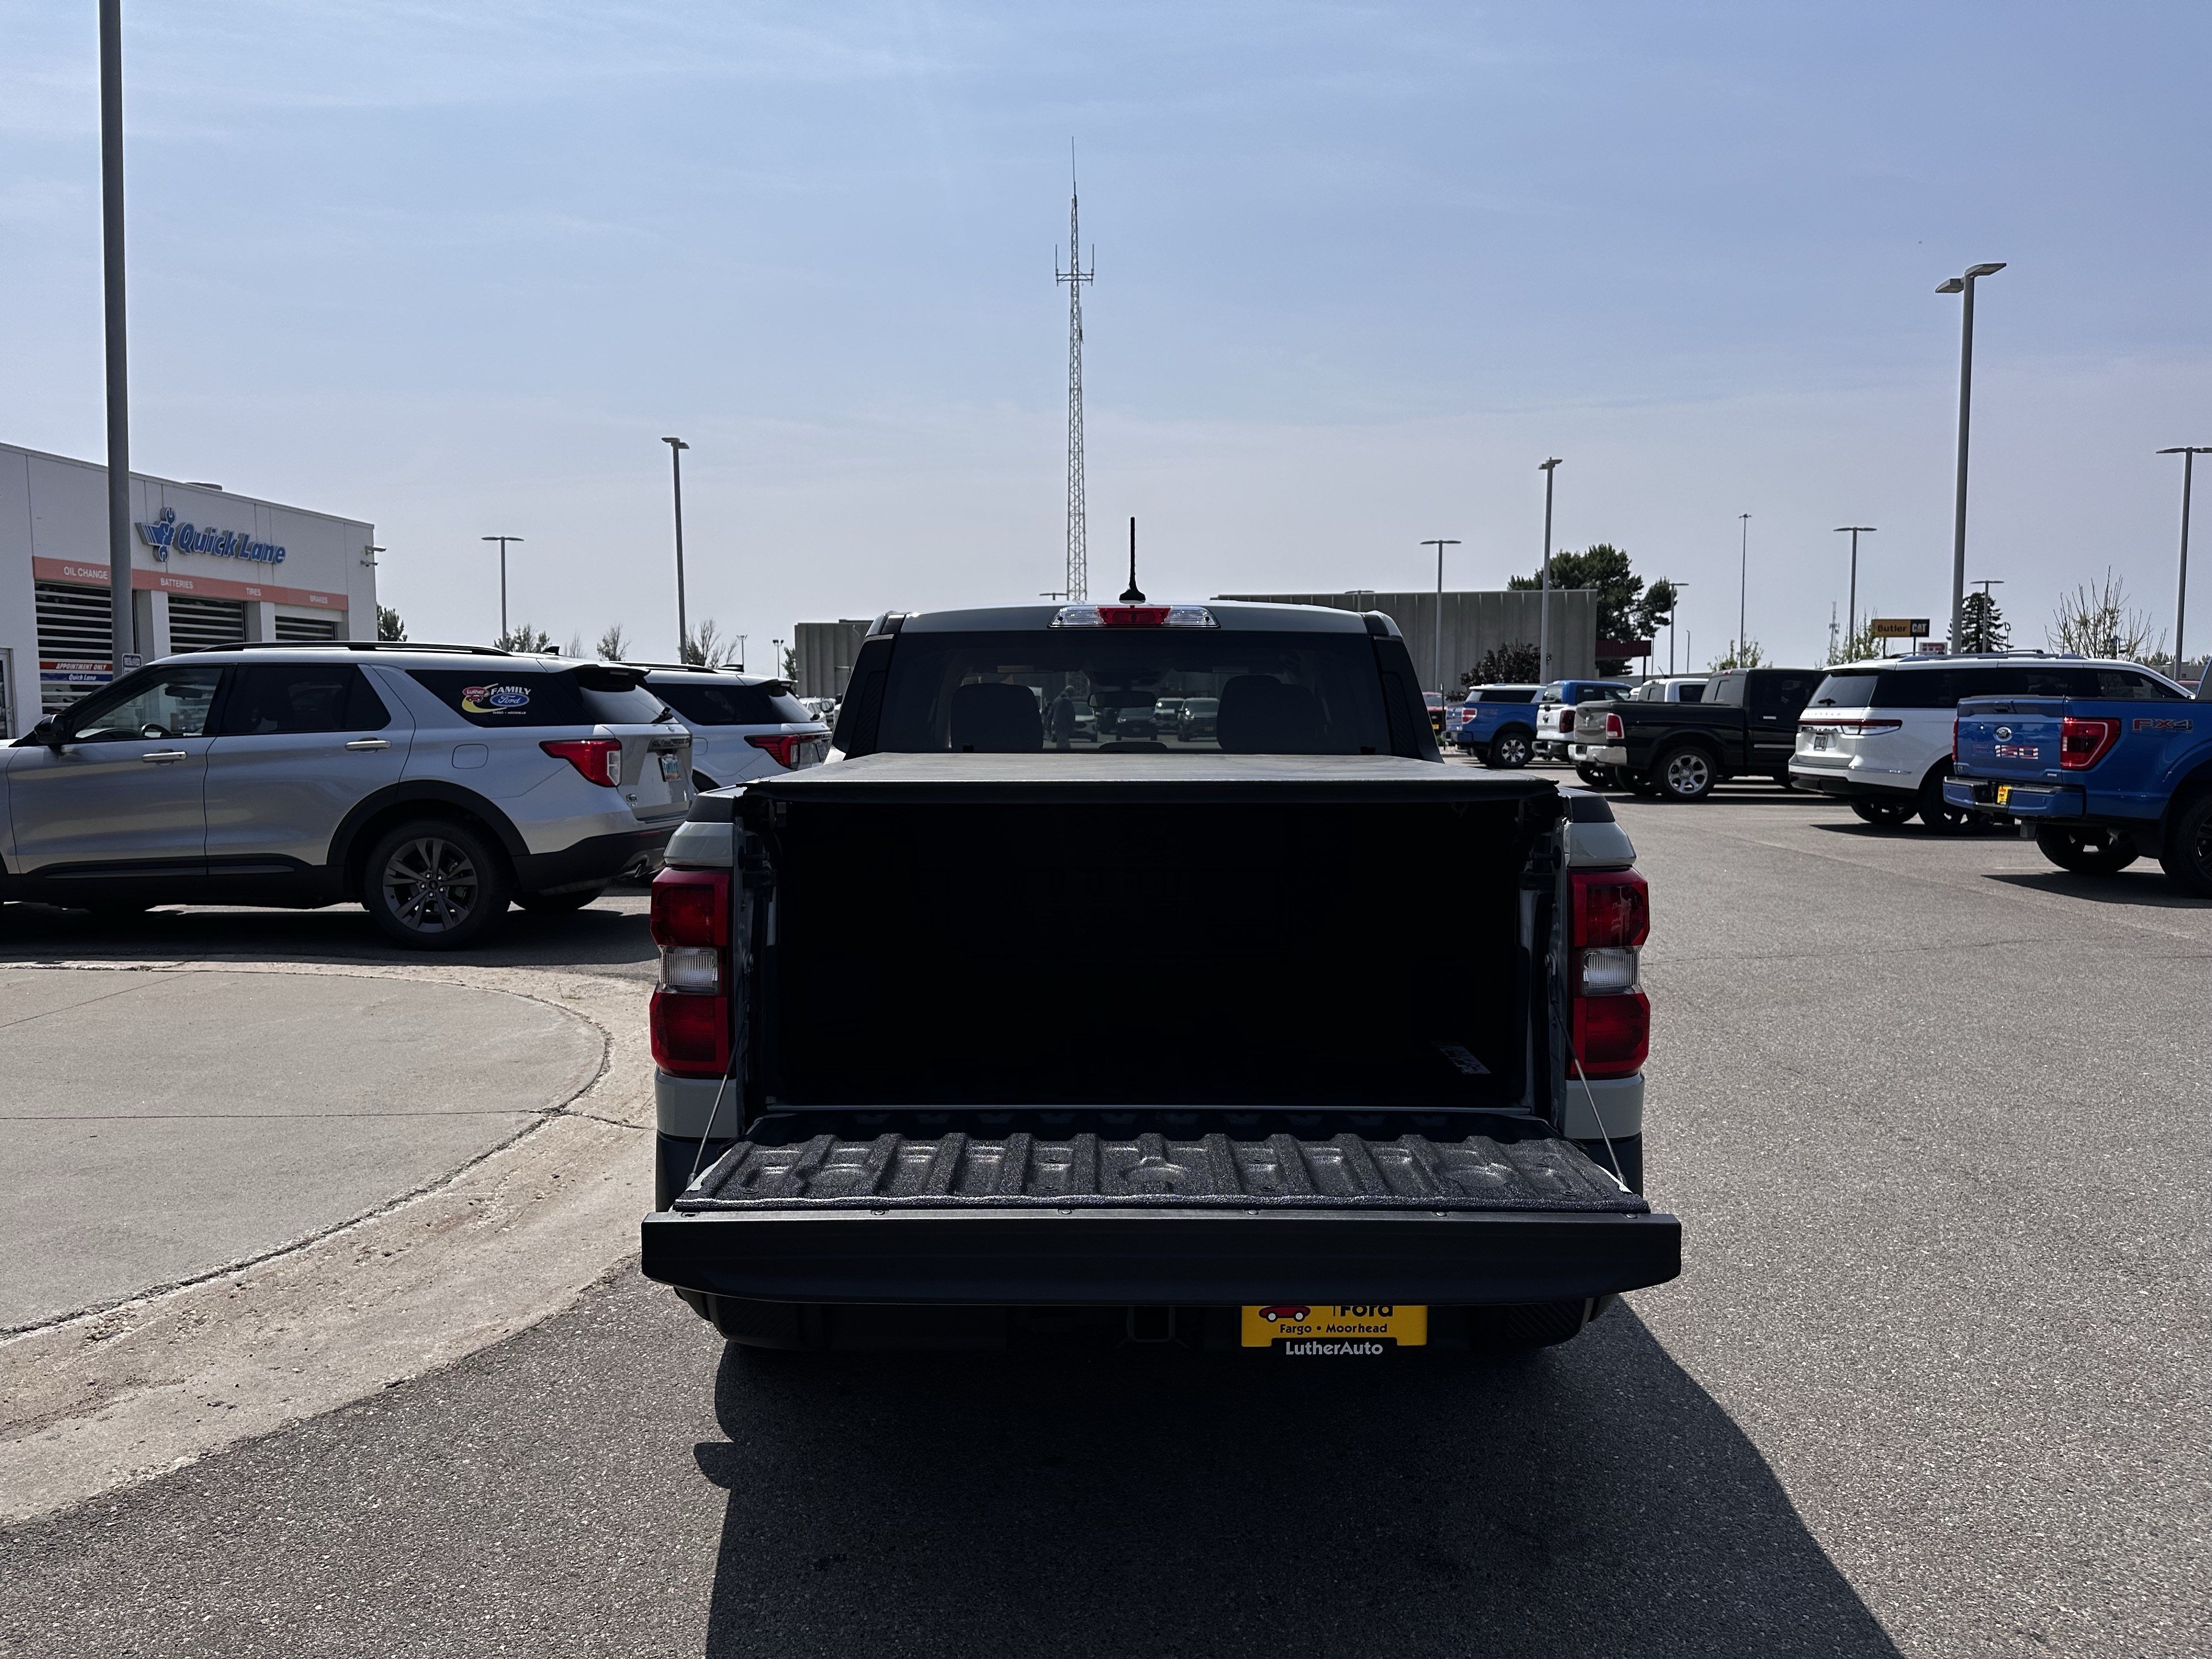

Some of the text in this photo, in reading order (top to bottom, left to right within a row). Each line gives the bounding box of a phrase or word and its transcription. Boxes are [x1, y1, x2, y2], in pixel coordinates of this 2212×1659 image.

[178, 523, 286, 564] Quick Lane
[64, 566, 108, 579] OIL CHANGE
[160, 578, 194, 589] BATTERIES
[1877, 623, 1927, 633] Butler CAT
[55, 662, 93, 670] APPOINTMENT
[490, 686, 532, 696] FAMILY
[498, 695, 522, 704] Ford
[2132, 718, 2193, 732] FX4
[1279, 1323, 1387, 1335] Fargo Moorhead
[1285, 1341, 1383, 1356] LutherAuto
